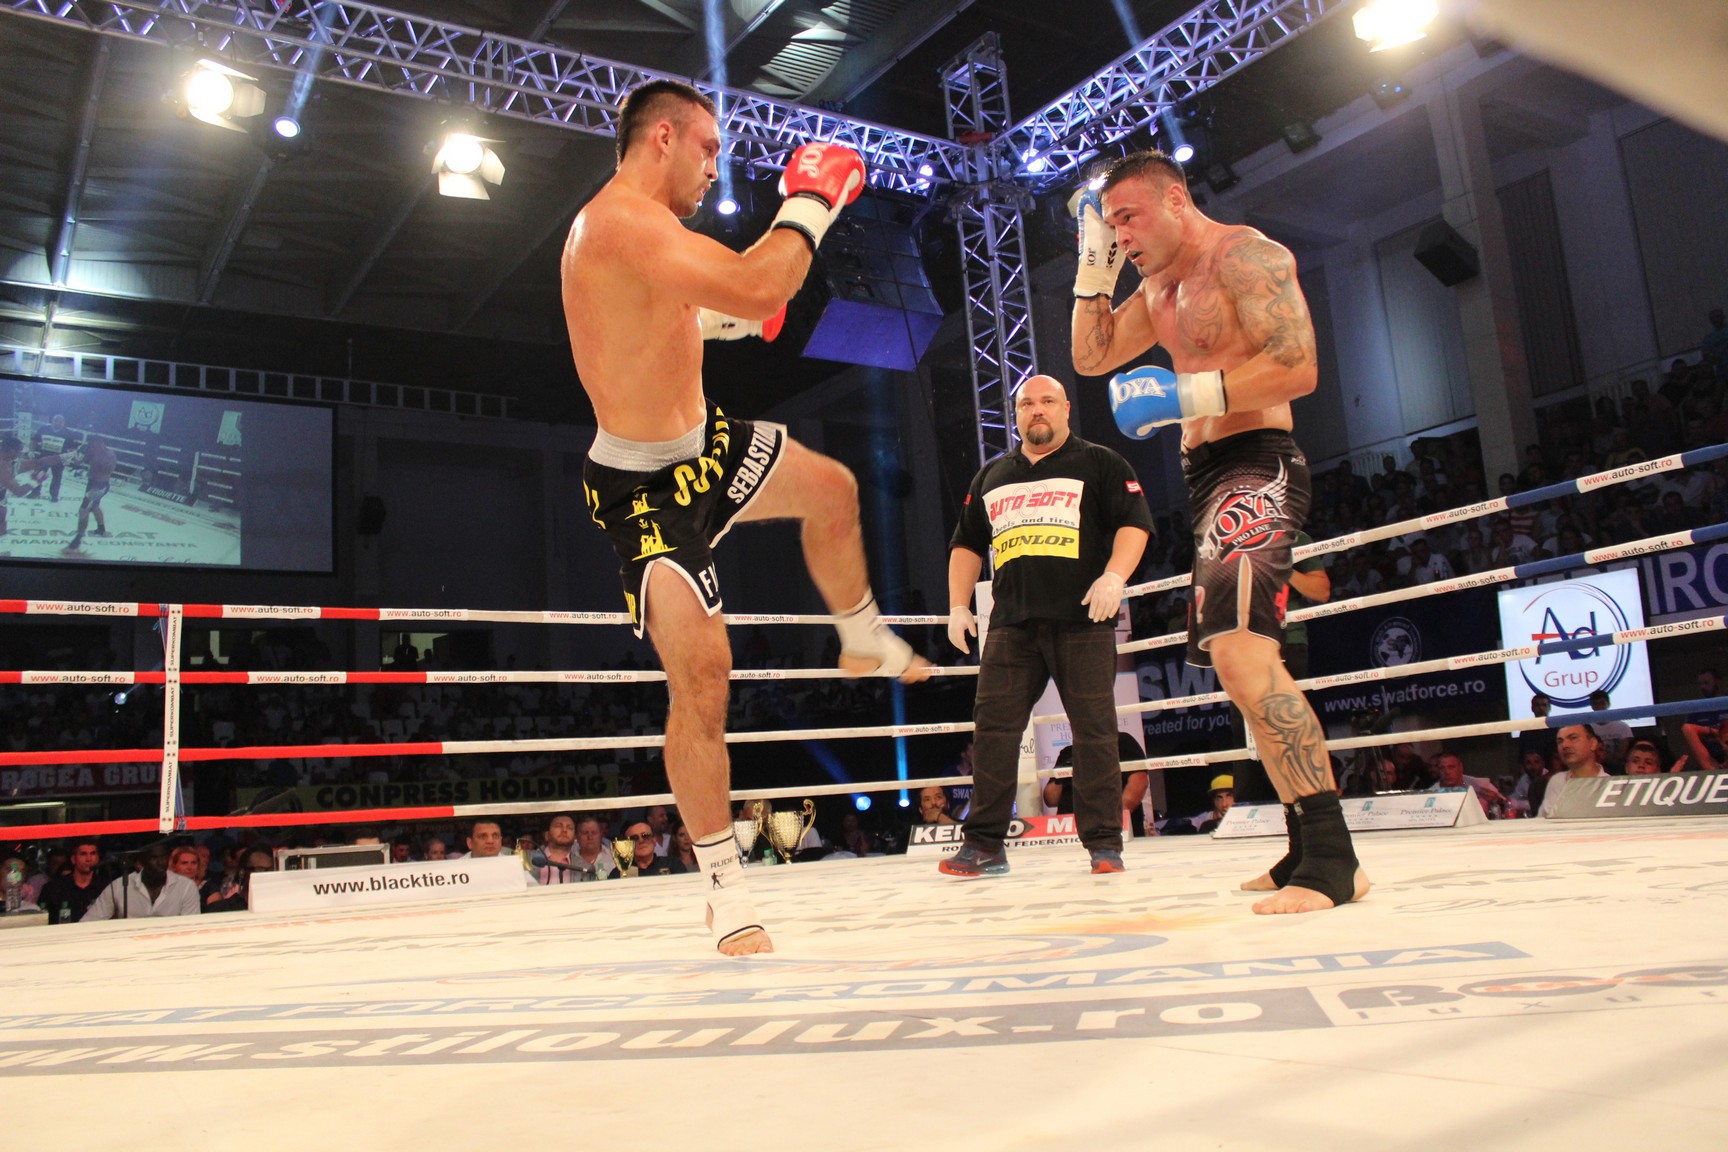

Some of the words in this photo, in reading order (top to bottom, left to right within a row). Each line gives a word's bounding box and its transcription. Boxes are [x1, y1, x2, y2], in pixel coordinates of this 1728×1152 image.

[1584, 458, 1673, 486] www.auto-soft.ro
[1026, 491, 1079, 508] SOFT
[1049, 517, 1076, 526] tires
[1426, 501, 1499, 523] www.auto-soft.ro
[1232, 532, 1251, 546] PRO
[1250, 523, 1271, 539] LINE
[1001, 535, 1075, 554] DUNLOP
[1294, 537, 1356, 557] www.auto-soft.ro
[1592, 539, 1684, 563] www.auto-soft.ro
[1433, 572, 1508, 594] www.auto-soft.ro
[36, 603, 130, 614] www.auto-soft.ro
[230, 606, 314, 615] www.auto-soft.ro
[387, 609, 462, 618] www.auto-soft.ro
[549, 612, 617, 620] www.auto-soft.ro
[734, 614, 794, 623] www.auto-soft.ro
[1621, 619, 1715, 640] www.auto-soft.ro
[1453, 646, 1530, 665] www.auto-soft.ro
[31, 674, 126, 683] www.auto-soft.ro
[257, 674, 340, 683] www.auto-soft.ro
[434, 674, 508, 682] www.auto-soft.ro
[564, 672, 633, 681] www.auto-soft.ro
[1315, 671, 1380, 685] www.auto-soft.ro
[1544, 669, 1599, 689] Grup
[1325, 679, 1486, 713] www.swatforce.ro
[1187, 713, 1206, 730] for
[316, 781, 470, 809] CONPRESS
[479, 775, 608, 801] HOLDING
[313, 872, 470, 896] www.blacktie.ro
[267, 990, 722, 1018] FORCE
[748, 949, 1497, 1002] ROMANIA
